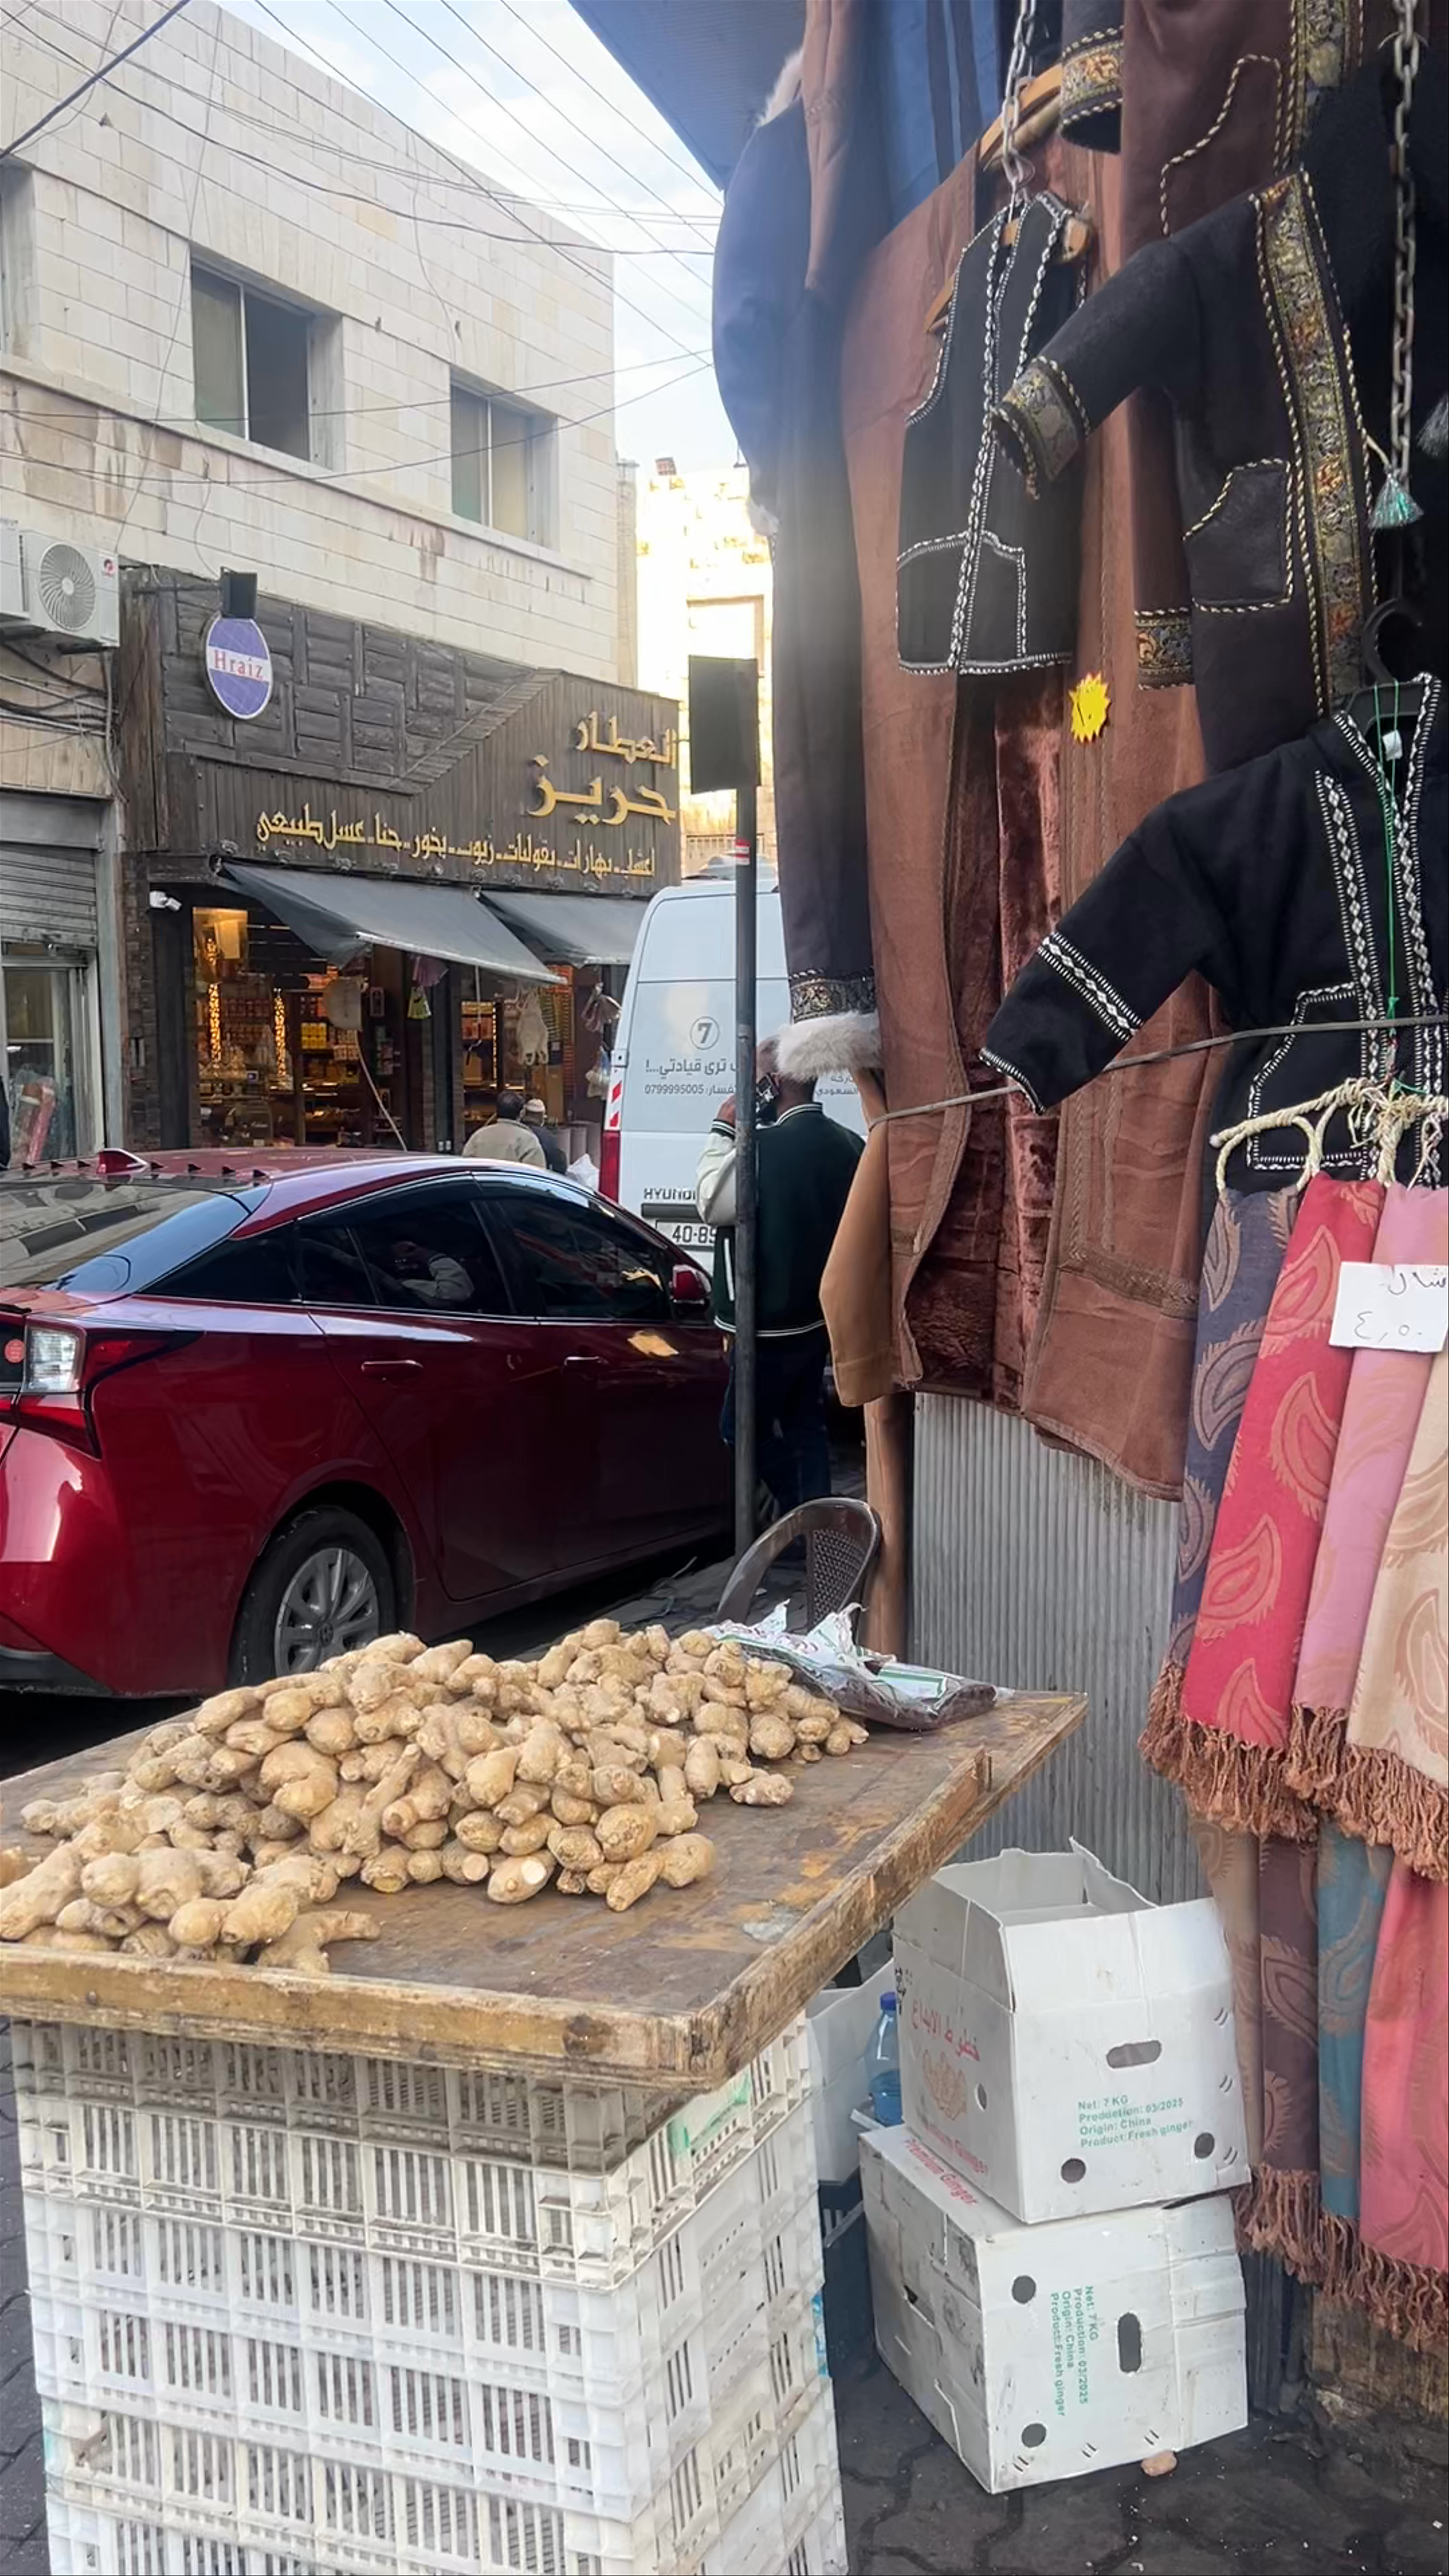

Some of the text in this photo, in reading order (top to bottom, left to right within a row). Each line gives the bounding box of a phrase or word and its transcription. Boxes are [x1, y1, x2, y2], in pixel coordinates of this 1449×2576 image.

[214, 650, 263, 681] Hraiz
[576, 711, 677, 770] العطار
[527, 754, 677, 826] حريز
[257, 803, 324, 852] طبيعي
[323, 810, 365, 850] عسل
[697, 1022, 713, 1044] 7
[645, 1084, 704, 1095] 0799995005
[644, 1188, 695, 1200] HYUND
[1078, 2095, 1128, 2110] Net: 7 KG
[1079, 2098, 1184, 2123] Production: 03/2025
[1080, 2117, 1151, 2136] Origin: China
[1159, 2120, 1194, 2137] ginger
[940, 2173, 977, 2204] Ginger
[1085, 2285, 1094, 2311] Net:
[1062, 2291, 1075, 2368] Origin: China
[1089, 2322, 1099, 2341] KG
[1074, 2288, 1088, 2404] Production: 03/2025
[1055, 2379, 1065, 2416] ginger
